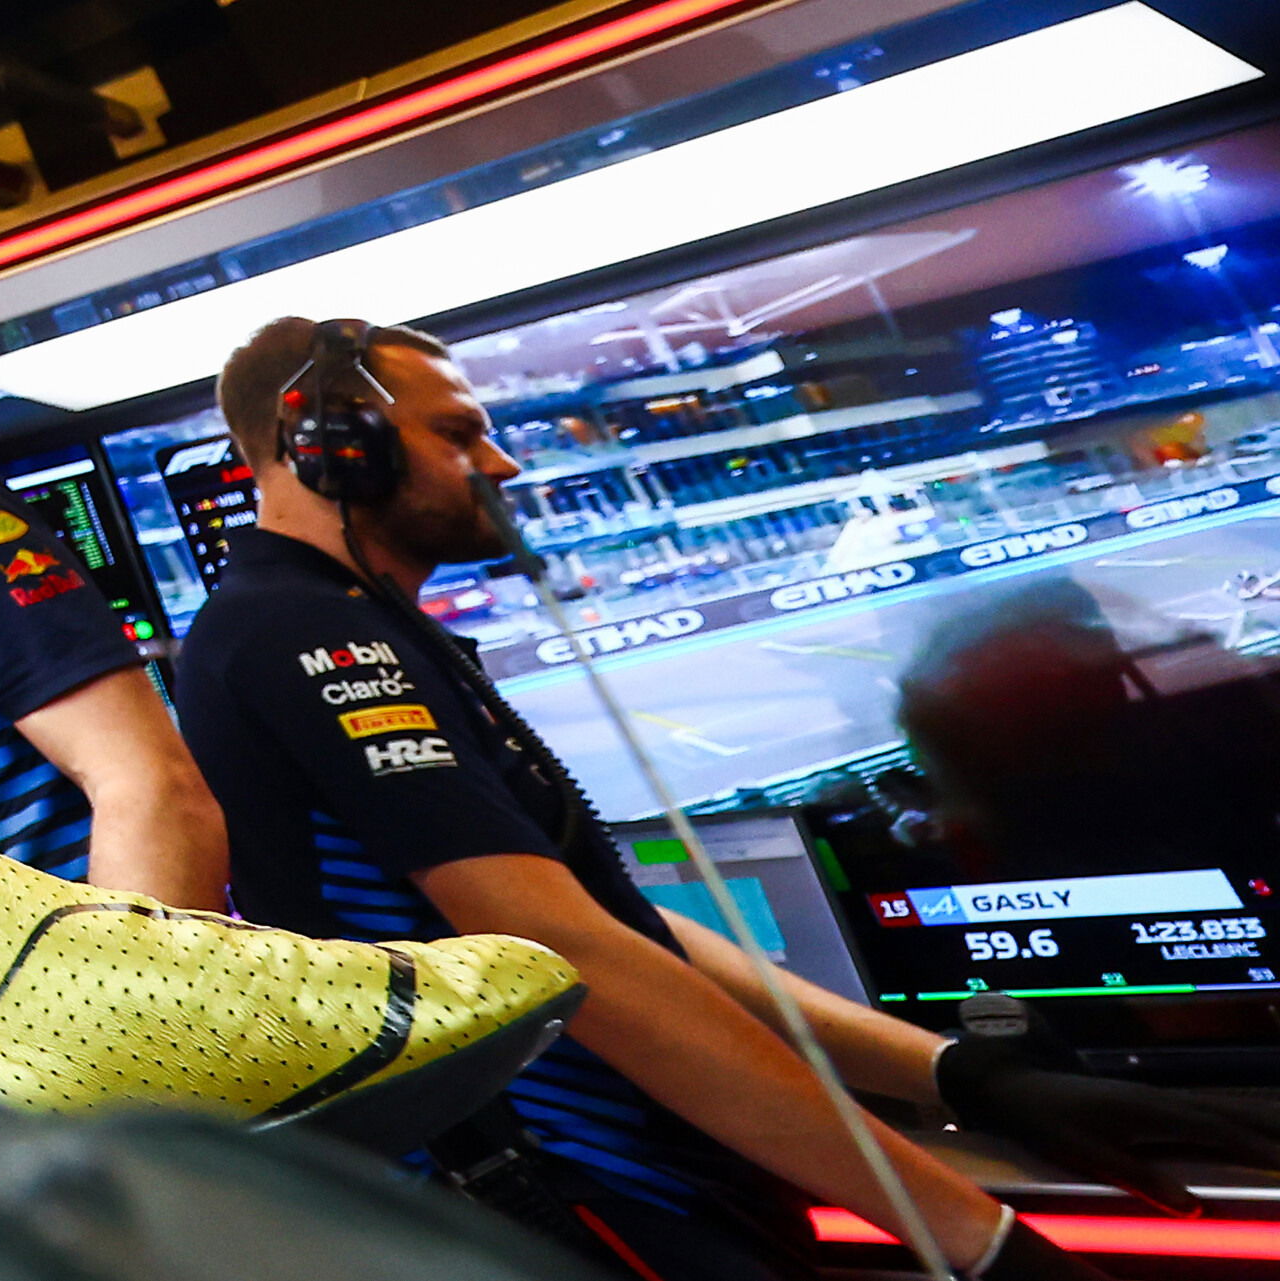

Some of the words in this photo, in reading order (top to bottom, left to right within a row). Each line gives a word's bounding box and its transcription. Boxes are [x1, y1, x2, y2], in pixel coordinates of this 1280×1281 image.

[536, 608, 705, 665] ETIHAD
[298, 641, 400, 677] Mobil
[972, 889, 1071, 912] GASLY
[964, 928, 1059, 961] 59.6
